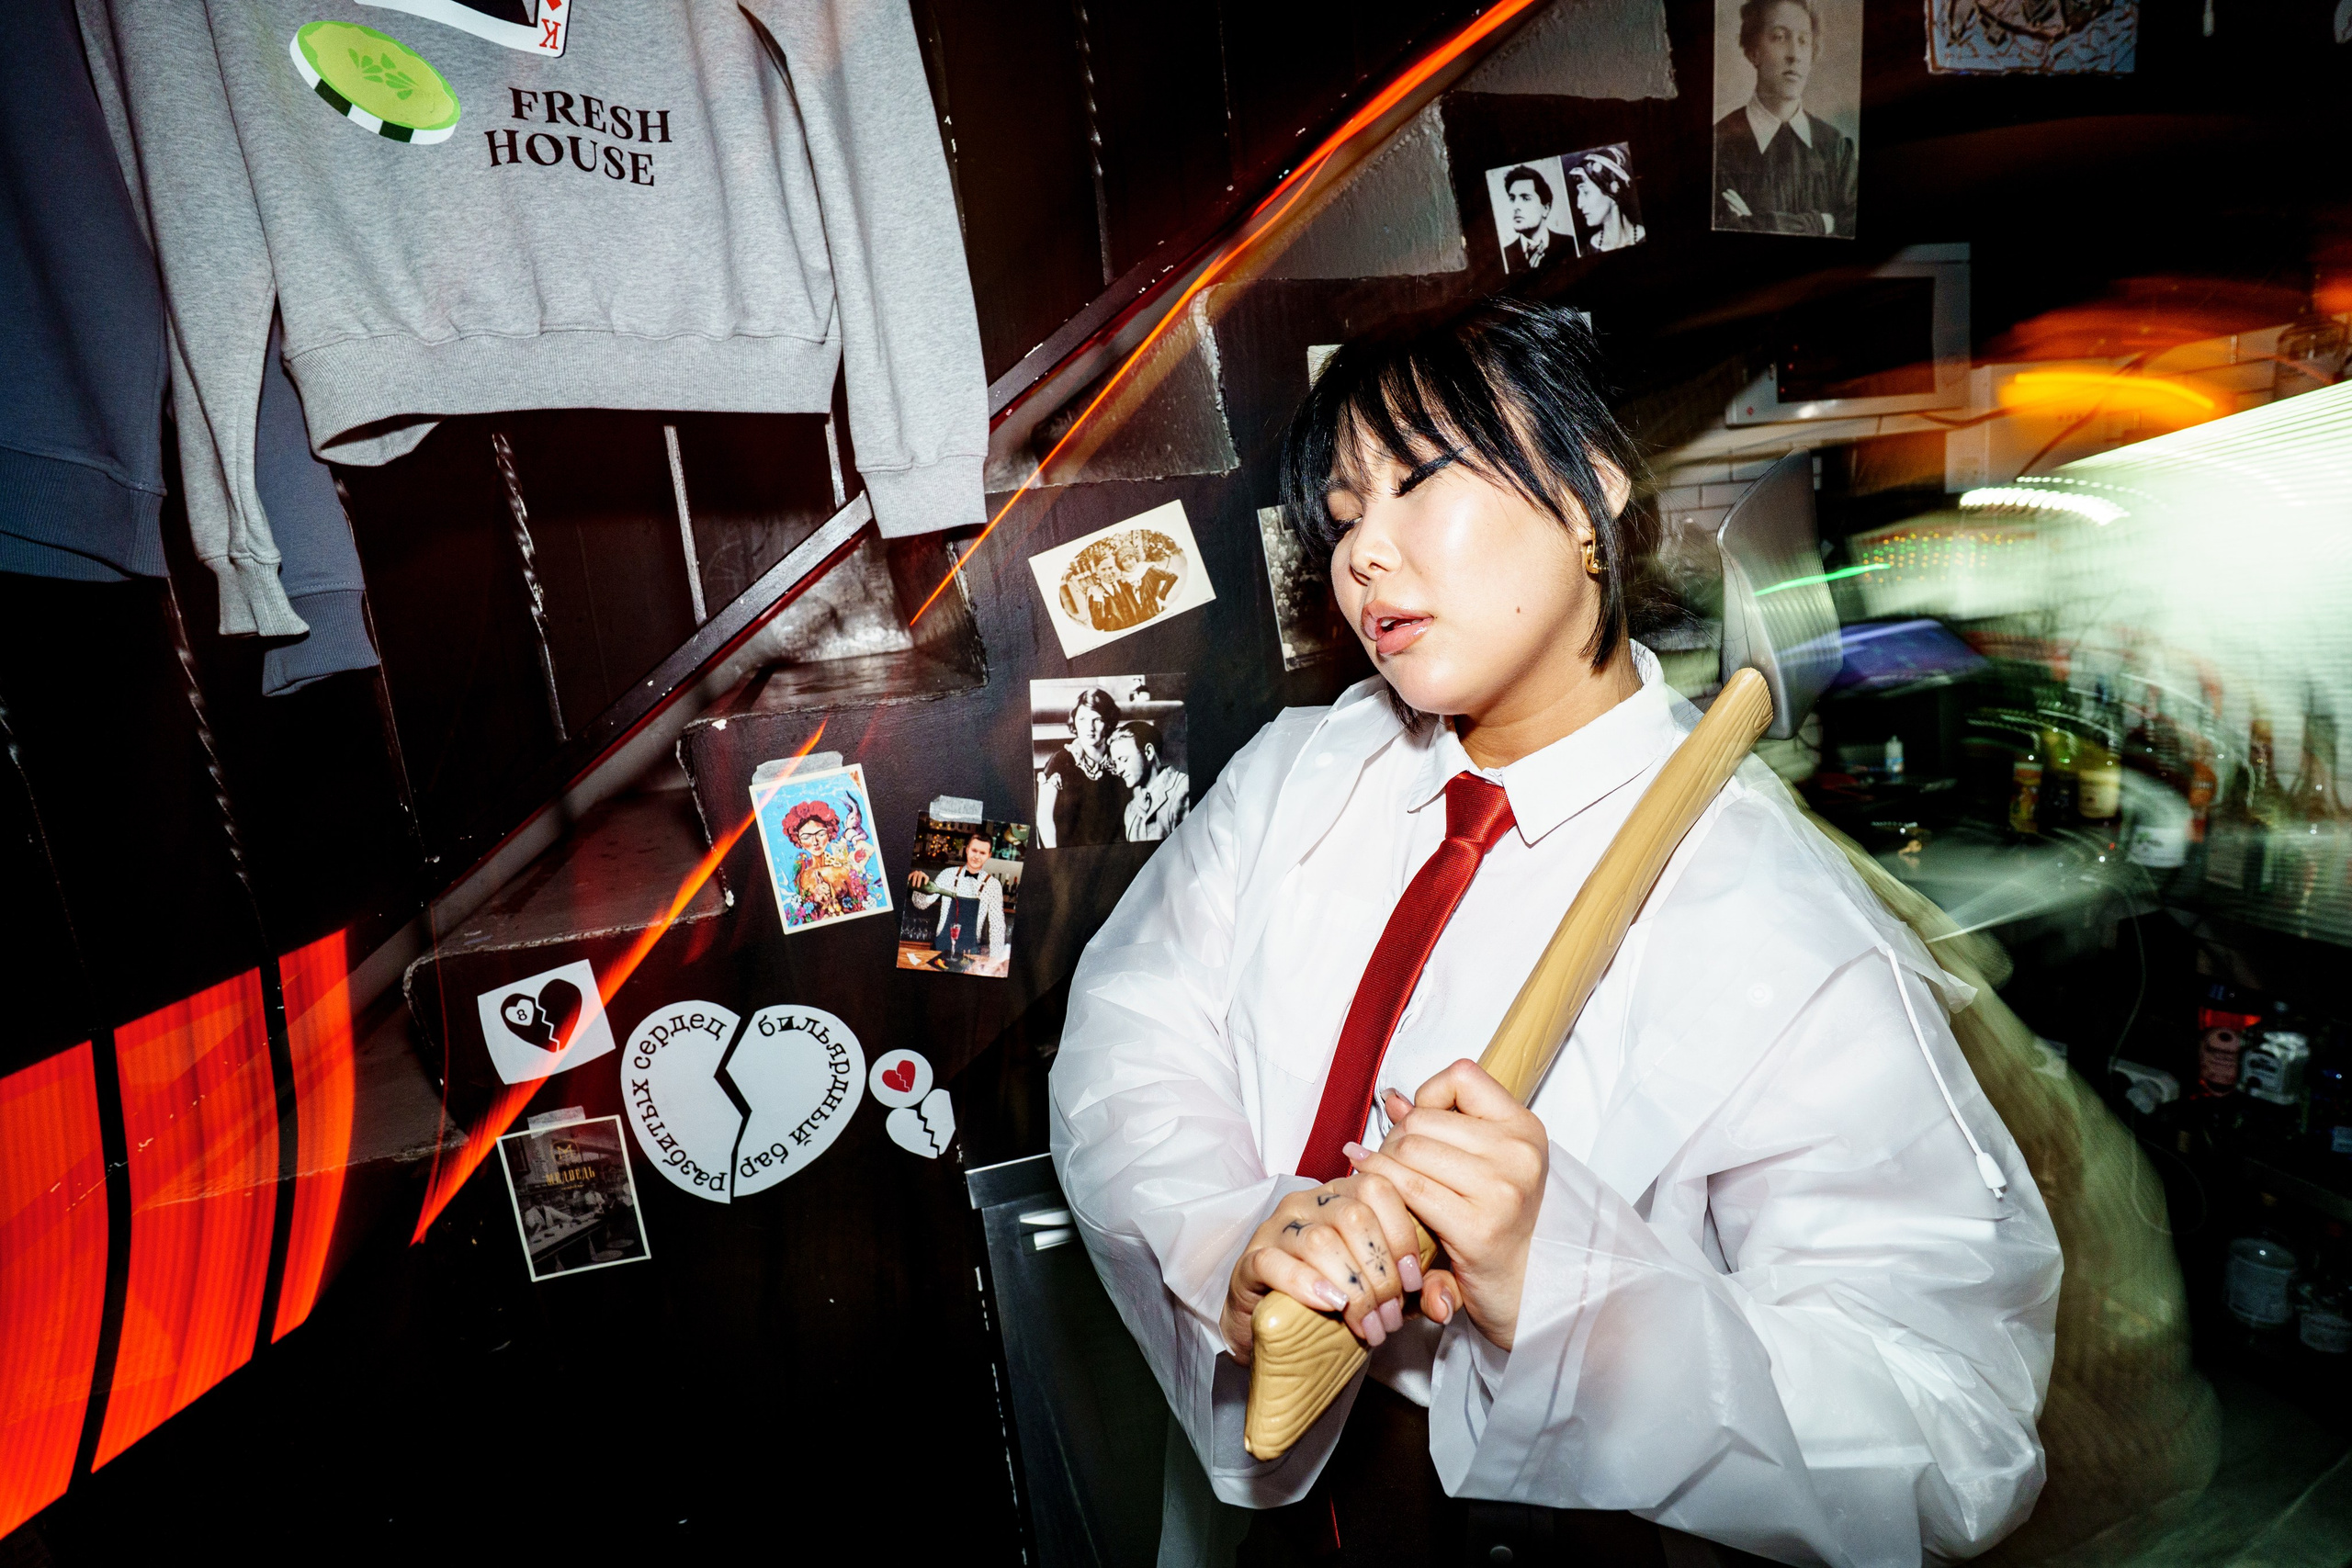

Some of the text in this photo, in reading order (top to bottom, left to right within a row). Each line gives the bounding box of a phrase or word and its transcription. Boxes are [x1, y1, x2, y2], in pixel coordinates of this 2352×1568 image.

[539, 18, 561, 50] K
[507, 86, 673, 143] FRESH
[484, 129, 655, 186] HOUSE
[516, 1009, 527, 1021] 8
[631, 1012, 851, 1191] бильярдный бар разбитых сердец
